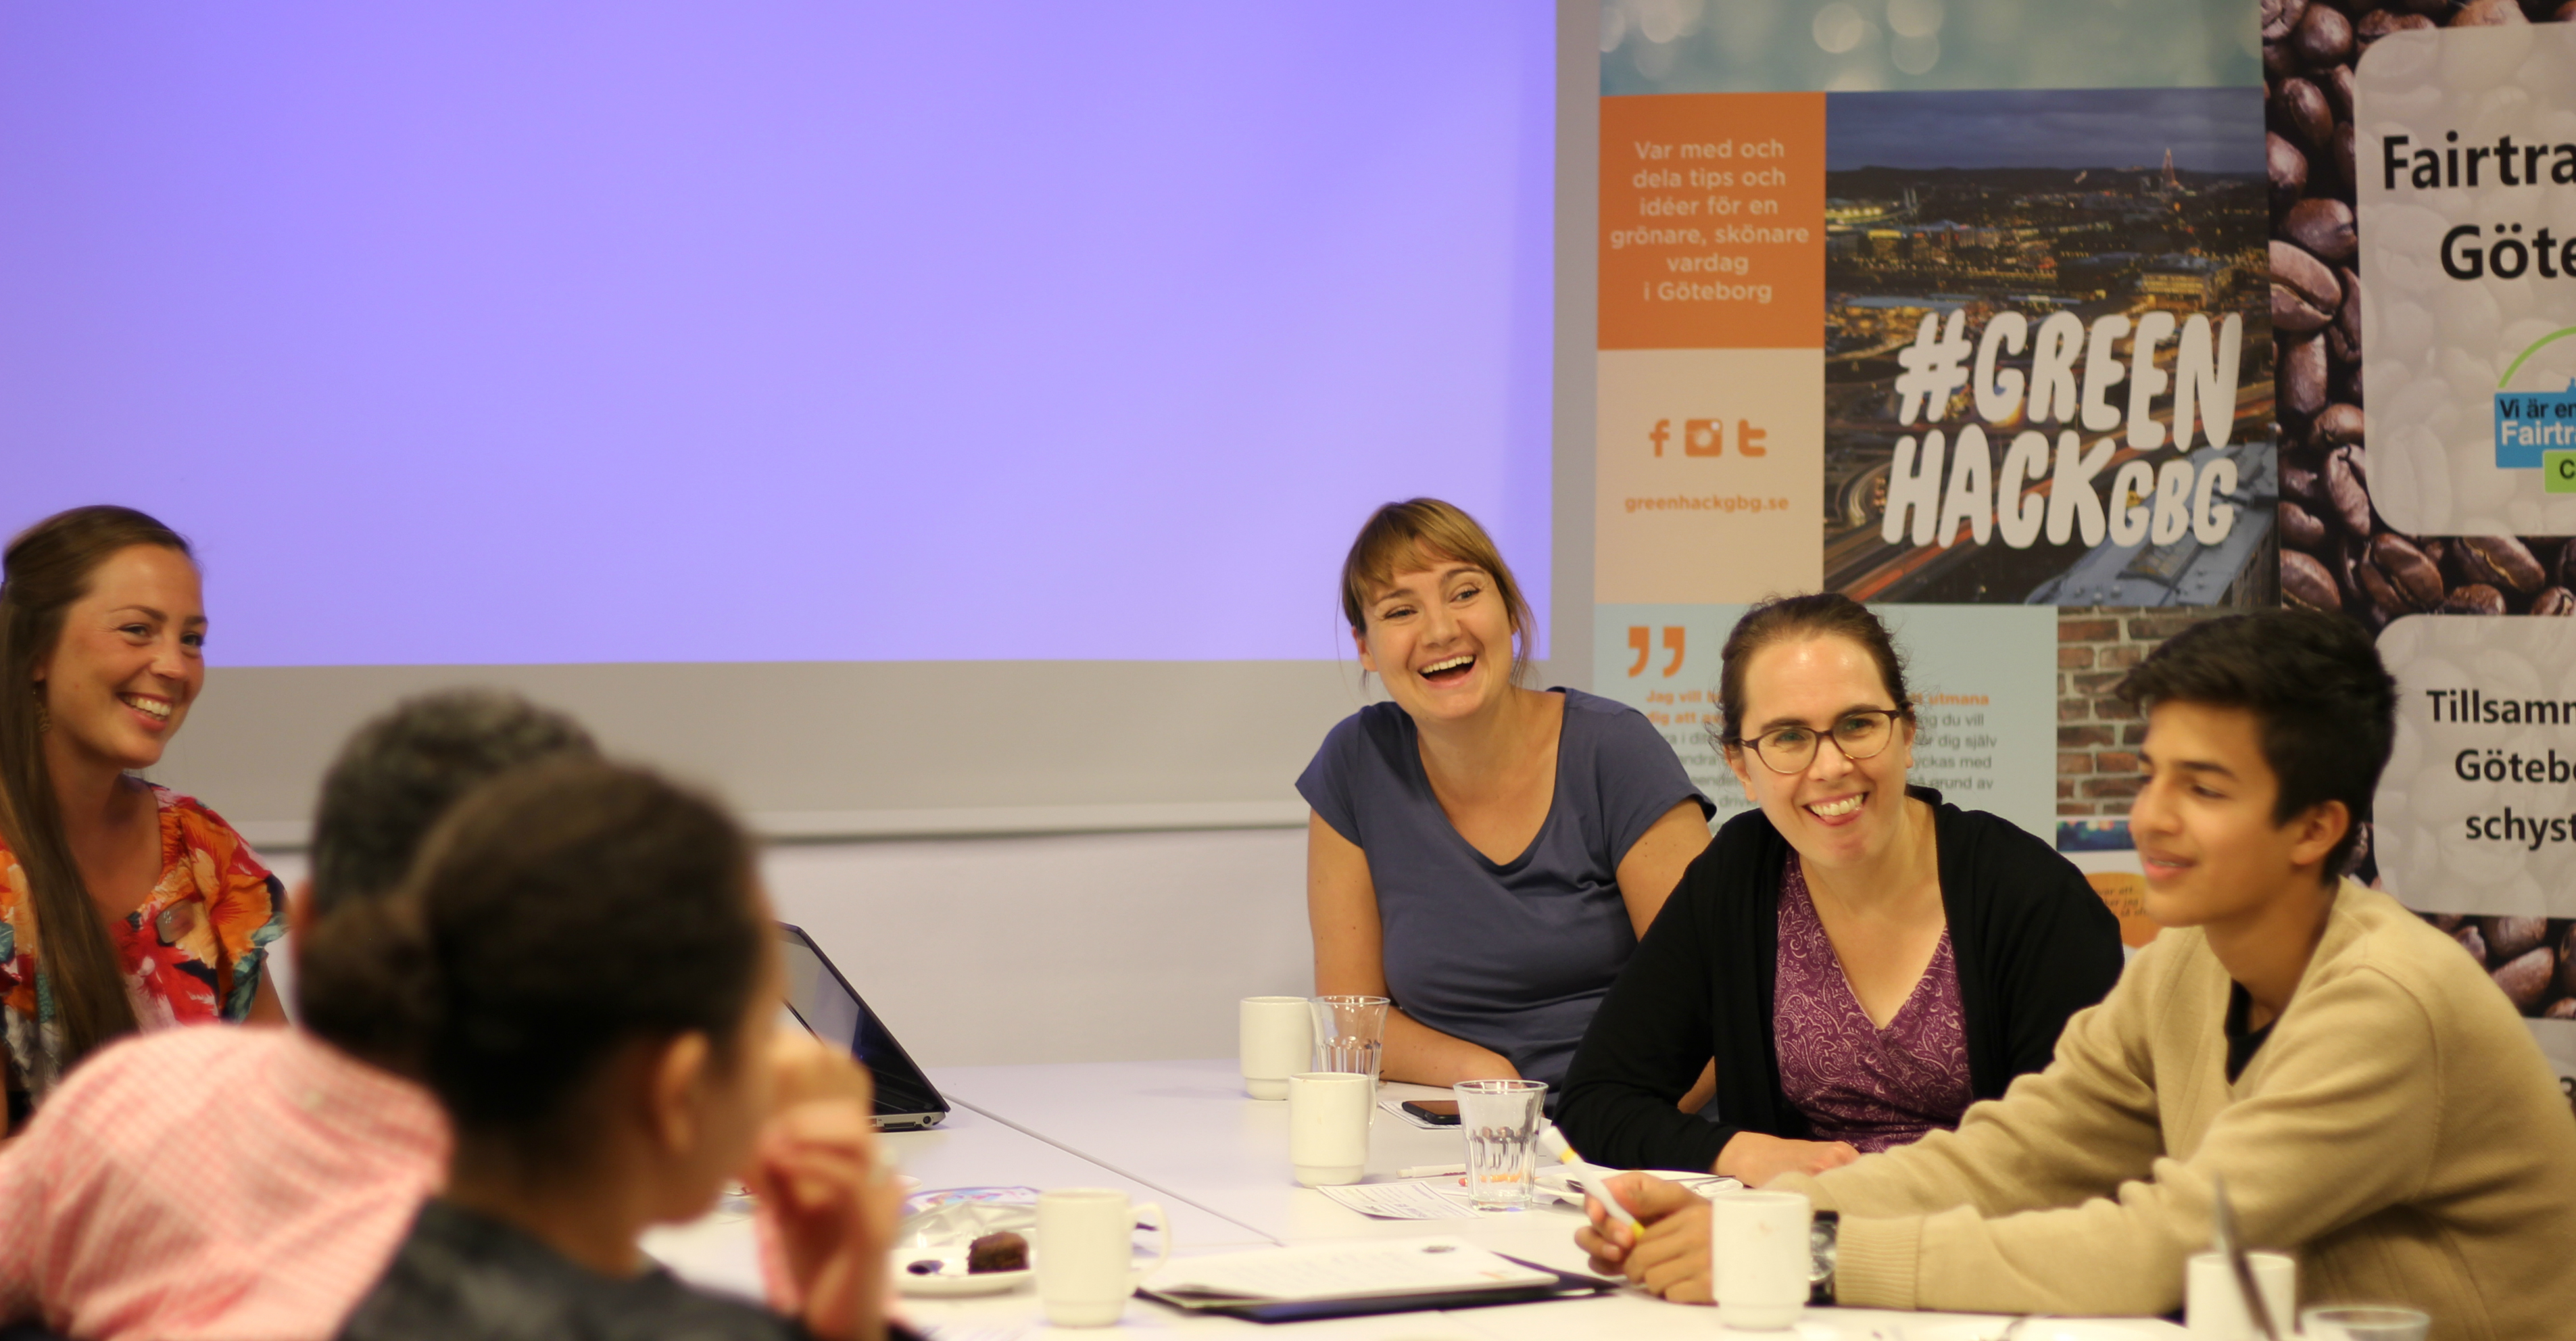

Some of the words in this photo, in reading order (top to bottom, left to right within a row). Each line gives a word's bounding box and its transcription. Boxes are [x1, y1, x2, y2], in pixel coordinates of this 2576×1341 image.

[1634, 141, 1673, 160] Var
[1680, 139, 1732, 158] med
[1740, 139, 1785, 157] och
[2383, 130, 2576, 190] Fairtra
[1632, 169, 1682, 189] dela
[1690, 168, 1734, 190] tips
[1741, 166, 1787, 187] och
[1639, 197, 1700, 216] idéer
[1706, 195, 1741, 216] för
[1749, 199, 1778, 215] en
[1609, 226, 1707, 249] grönare,
[1715, 224, 1809, 244] skönare
[1666, 252, 1749, 276] vardag
[1643, 282, 1649, 301] i
[1657, 281, 1772, 304] Göteborg
[1895, 308, 2243, 452] #GREEN
[2500, 398, 2520, 418] Vi
[2527, 398, 2549, 418] är
[2502, 420, 2576, 446] Fairtr
[1625, 495, 1789, 514] greenhackgbg.se
[1645, 689, 1674, 705] Jag
[1678, 690, 1703, 703] vill
[1928, 693, 1990, 705] utmana
[1675, 712, 1697, 724] att
[1942, 713, 1961, 726] du
[1965, 713, 1985, 727] vill
[1938, 734, 1960, 750] dig
[1965, 734, 1997, 750] själv
[1914, 755, 1955, 771] yckas
[1960, 754, 1992, 768] med
[2455, 748, 2576, 783] Göteb
[1976, 779, 1993, 789] av
